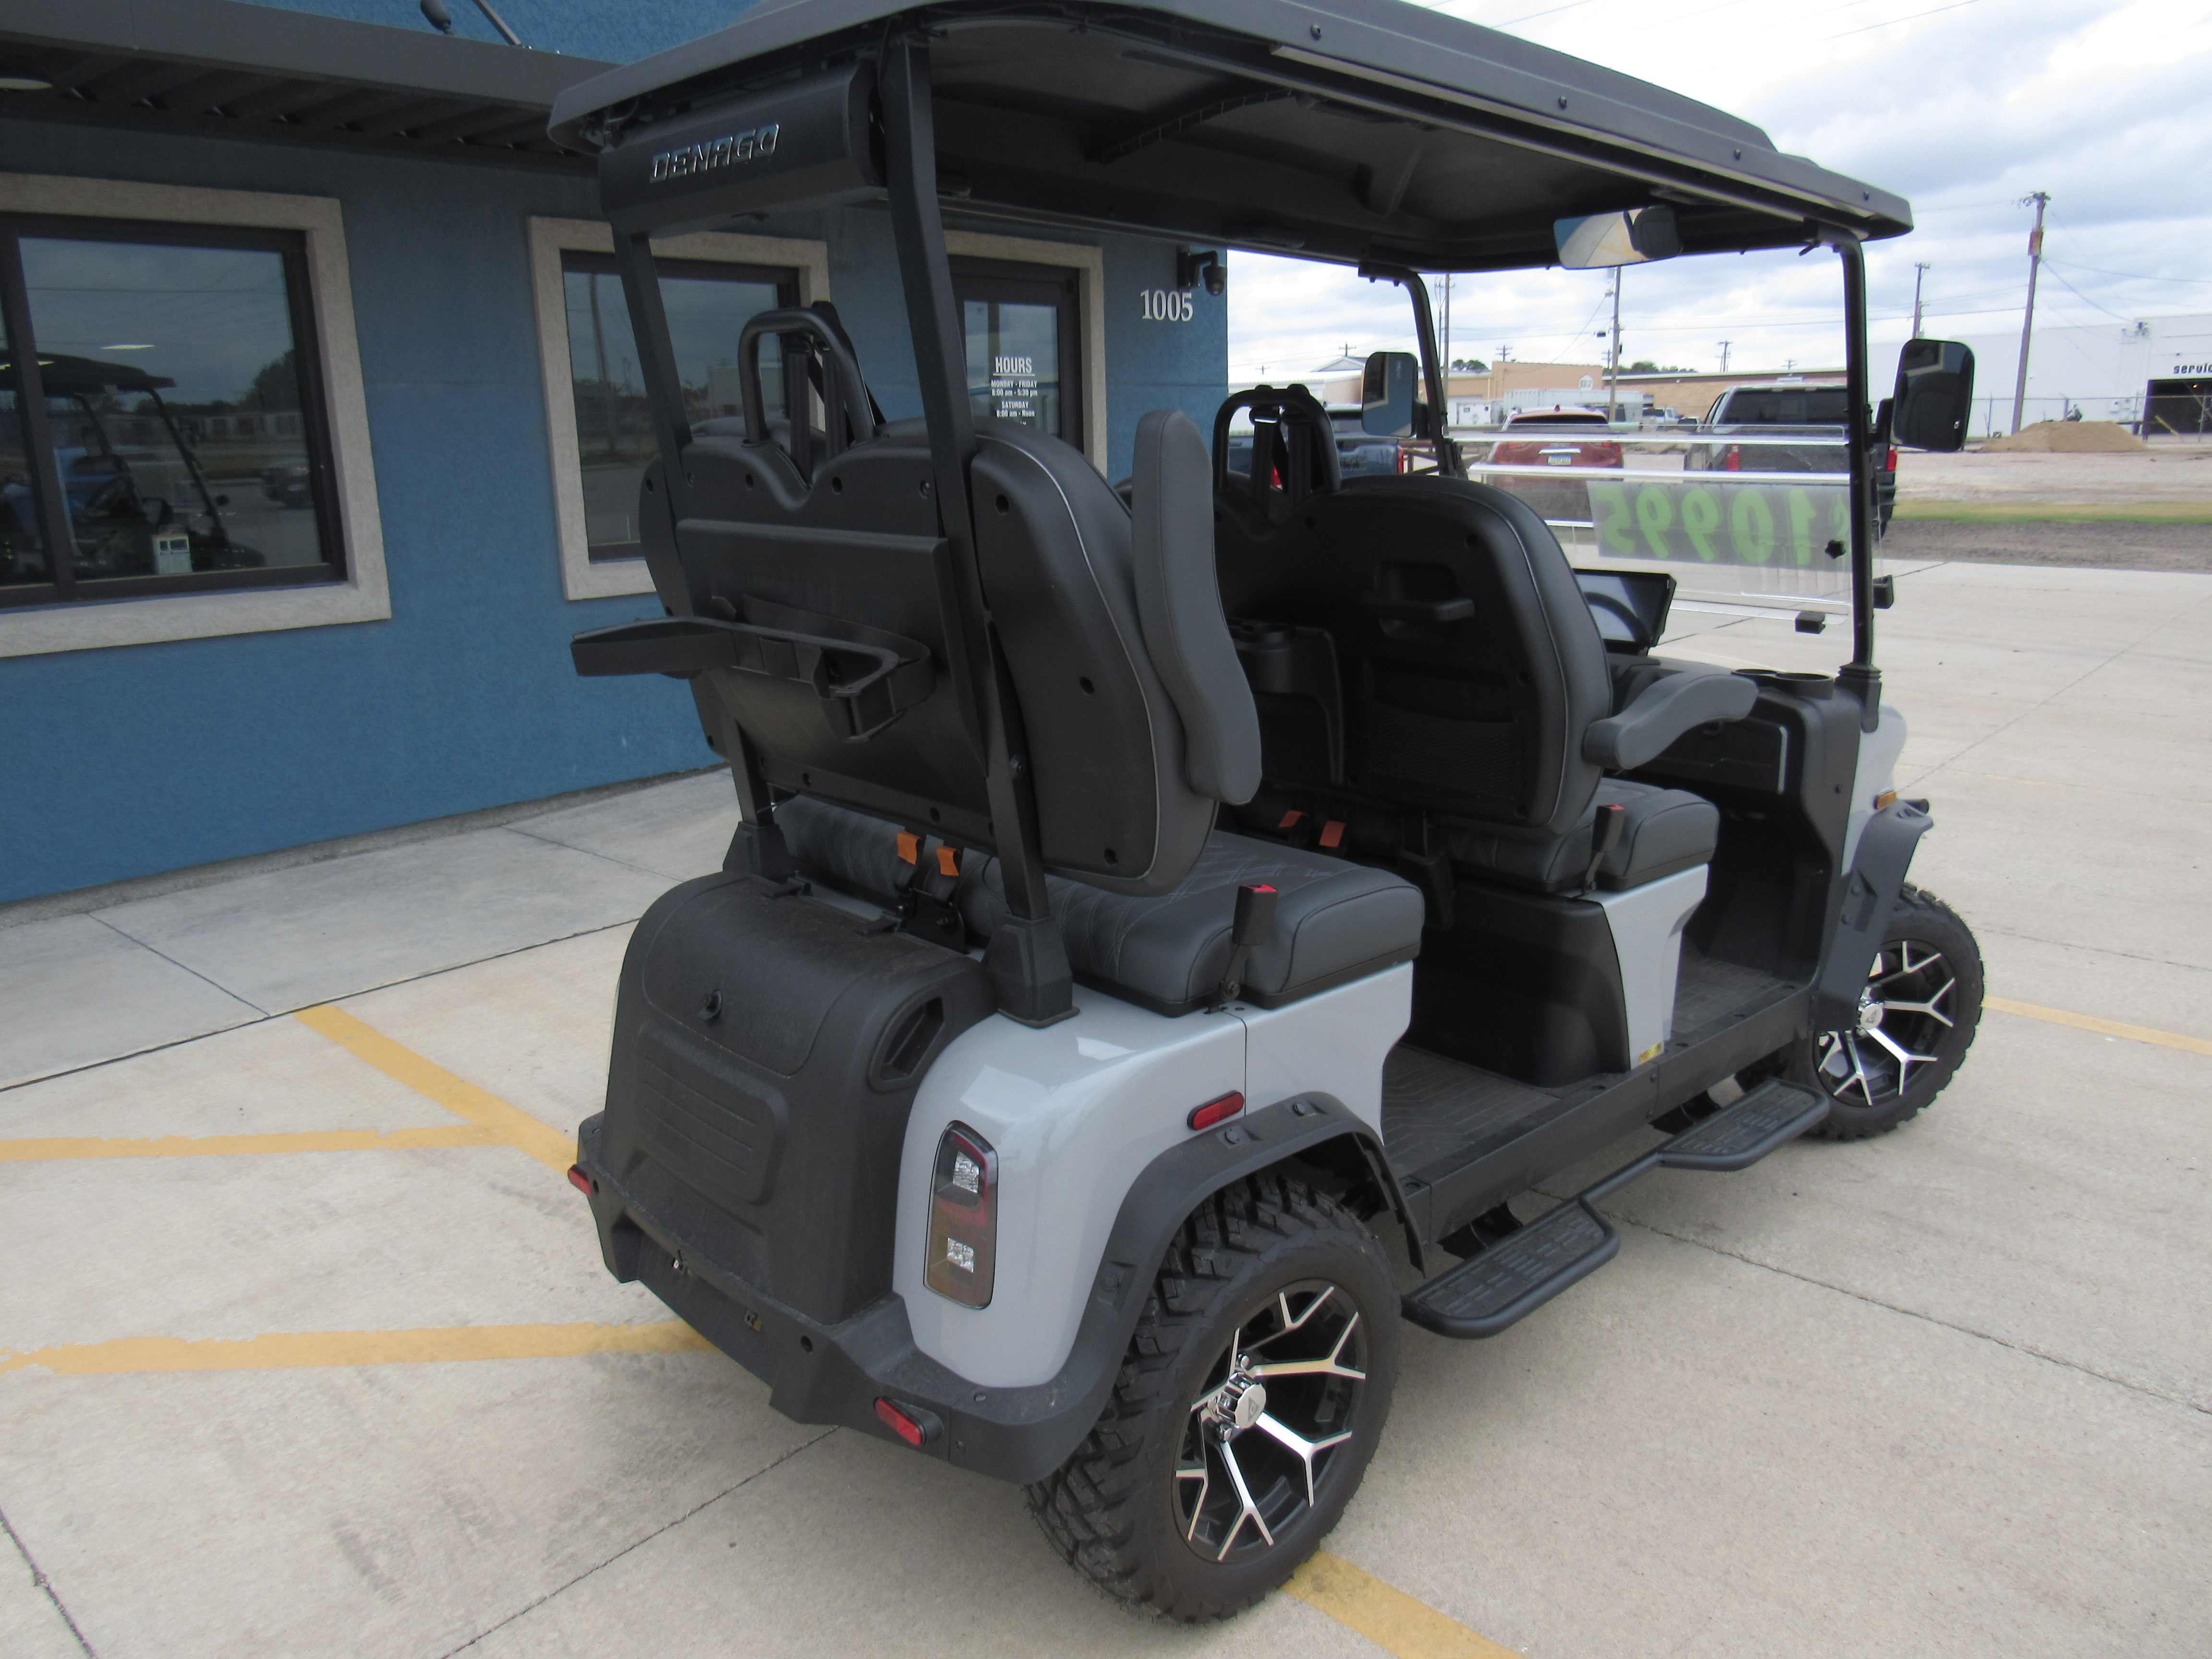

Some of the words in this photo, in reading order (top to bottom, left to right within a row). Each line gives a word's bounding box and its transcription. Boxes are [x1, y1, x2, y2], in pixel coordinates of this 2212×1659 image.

[649, 124, 780, 184] DENAGO
[1140, 289, 1193, 322] 1005
[995, 357, 1032, 373] HOURS
[991, 380, 1014, 388] MONDAY
[992, 388, 1004, 397] 8:00
[1030, 390, 1038, 398] pm
[1001, 401, 1029, 409] SATURDAY
